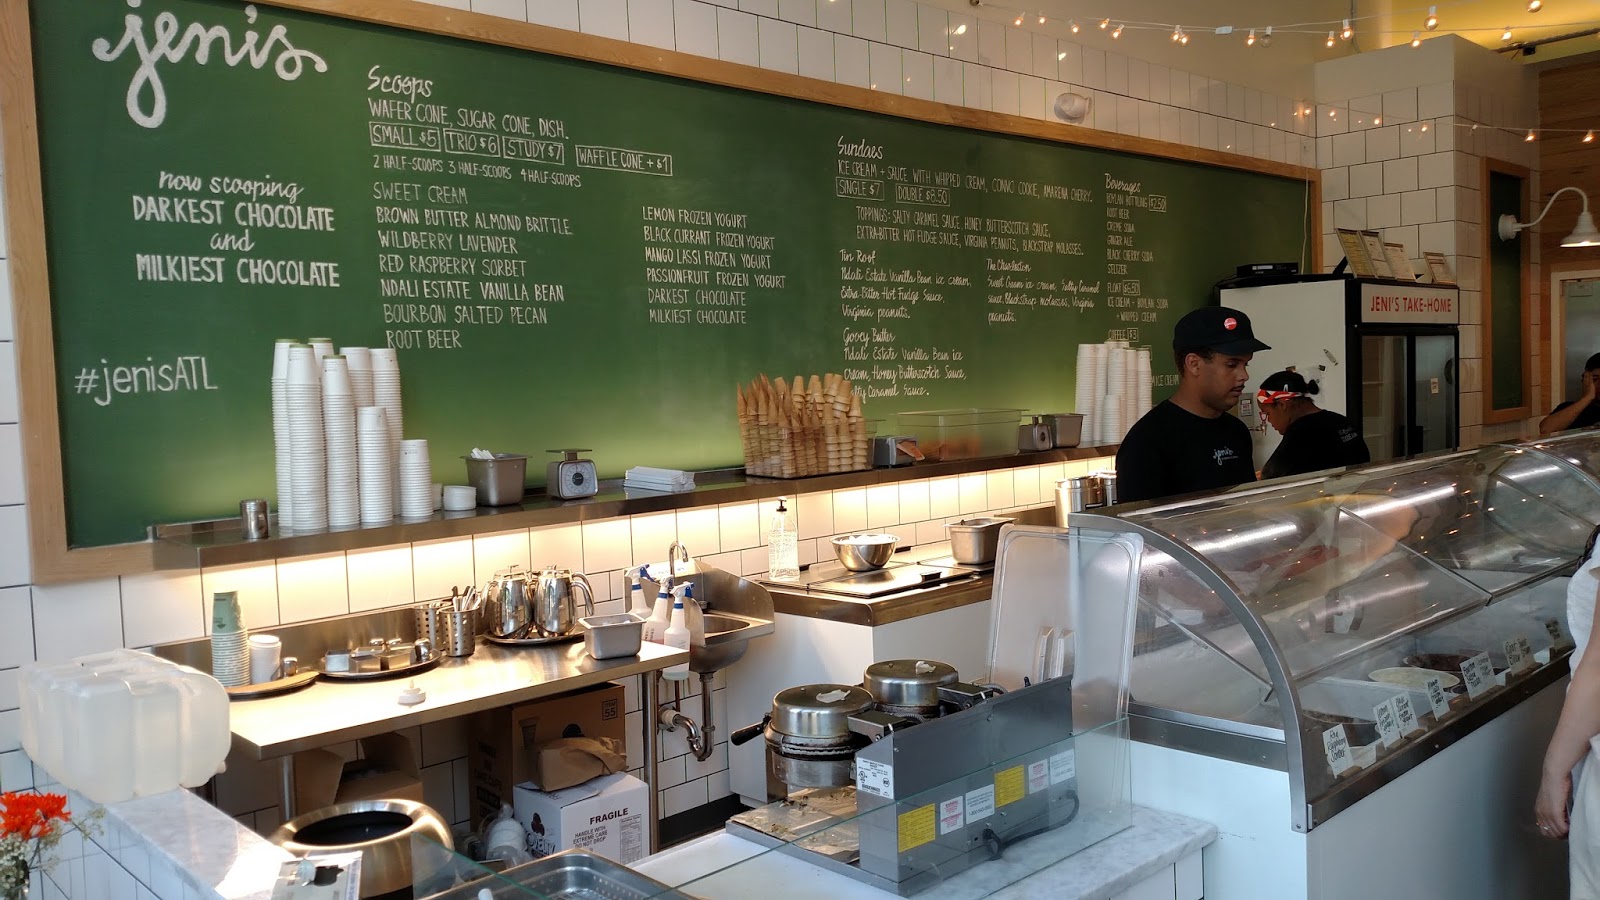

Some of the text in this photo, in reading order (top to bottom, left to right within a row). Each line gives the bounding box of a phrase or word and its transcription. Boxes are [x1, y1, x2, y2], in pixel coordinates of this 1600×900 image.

[92, 0, 327, 128] jeni's
[368, 65, 433, 103] Scoops
[368, 98, 569, 139] WAFER CONE, SUGAR CONE, DISH.
[373, 125, 437, 147] SMALL $5
[446, 131, 496, 153] TRIO $6
[508, 140, 562, 160] STUDY $7
[838, 136, 883, 159] Sundaes
[374, 155, 443, 172] 2 HALF-SCOOPS
[449, 161, 511, 179] 3 HALF-SCOOPS
[579, 149, 618, 166] WAFFLE
[620, 152, 645, 170] CONE
[657, 157, 668, 172] $1
[838, 160, 849, 175] ICE
[852, 162, 877, 177] CREAM
[888, 166, 907, 182] SAUCE
[913, 169, 931, 183] WITH
[935, 172, 960, 187] WHIPPED
[159, 171, 304, 202] now scooping
[373, 182, 468, 204] SWEET CREAM
[839, 180, 880, 196] SINGLE $7
[1105, 173, 1140, 195] Beverages
[898, 186, 947, 204] DOUBLE $8.50
[132, 196, 334, 231] DARKEST CHOCOLATE
[376, 207, 573, 235] BROWN BUTTER ALMOND BRITTLE
[642, 206, 747, 228] LEMON FROZEN YOGURT
[893, 210, 910, 224] SALTY
[915, 212, 939, 228] CARAMEL
[965, 217, 982, 231] HONEY
[987, 219, 1029, 235] BUTTERSCOTCH
[210, 229, 254, 252] and
[378, 230, 518, 254] WILDBERRY LAVENDER
[644, 226, 775, 250] BLACK CURRANT FROZEN YOGURT
[904, 229, 915, 242] HOT
[918, 230, 937, 244] FUDGE
[379, 254, 526, 277] RED RASPBERRY SORBET
[645, 247, 771, 269] MANGO LASSI FROZEN YOGURT
[840, 249, 876, 264] Tin Roof
[136, 254, 340, 287] MILKIEST CHOCOLATE
[647, 268, 786, 288] PASSIONFRUIT FROZEN YOGURT
[865, 268, 887, 282] Estate
[889, 269, 916, 283] Vanilla
[917, 270, 932, 284] Bean
[381, 279, 564, 301] NDALI ESTATE VANILLA BEAN
[648, 288, 746, 306] DARKEST CHOCOLATE
[882, 287, 896, 300] Hot
[898, 287, 919, 304] Fudge
[383, 304, 547, 324] BOURBON SALTED PECAN
[842, 304, 874, 321] Virginia
[1371, 296, 1451, 312] JENI'S TAKE-HOME
[650, 309, 746, 324] MILKIEST CHOCOLATE
[386, 330, 462, 349] ROOT BEER
[843, 327, 896, 347] Gooey Butter
[873, 347, 898, 360] Estate
[902, 347, 929, 360] Vanilla
[933, 347, 949, 360] Bean
[953, 349, 963, 360] ice
[75, 357, 218, 406] #jenisATL
[872, 365, 898, 384] Honey
[898, 365, 940, 379] Butterscotch
[868, 384, 899, 397] Caramel
[604, 707, 616, 718] 55
[590, 808, 628, 825] FRAGILE
[573, 830, 607, 844] EXTREME CARE
[575, 826, 605, 837] HANDLE WITH
[594, 837, 606, 845] DROP
